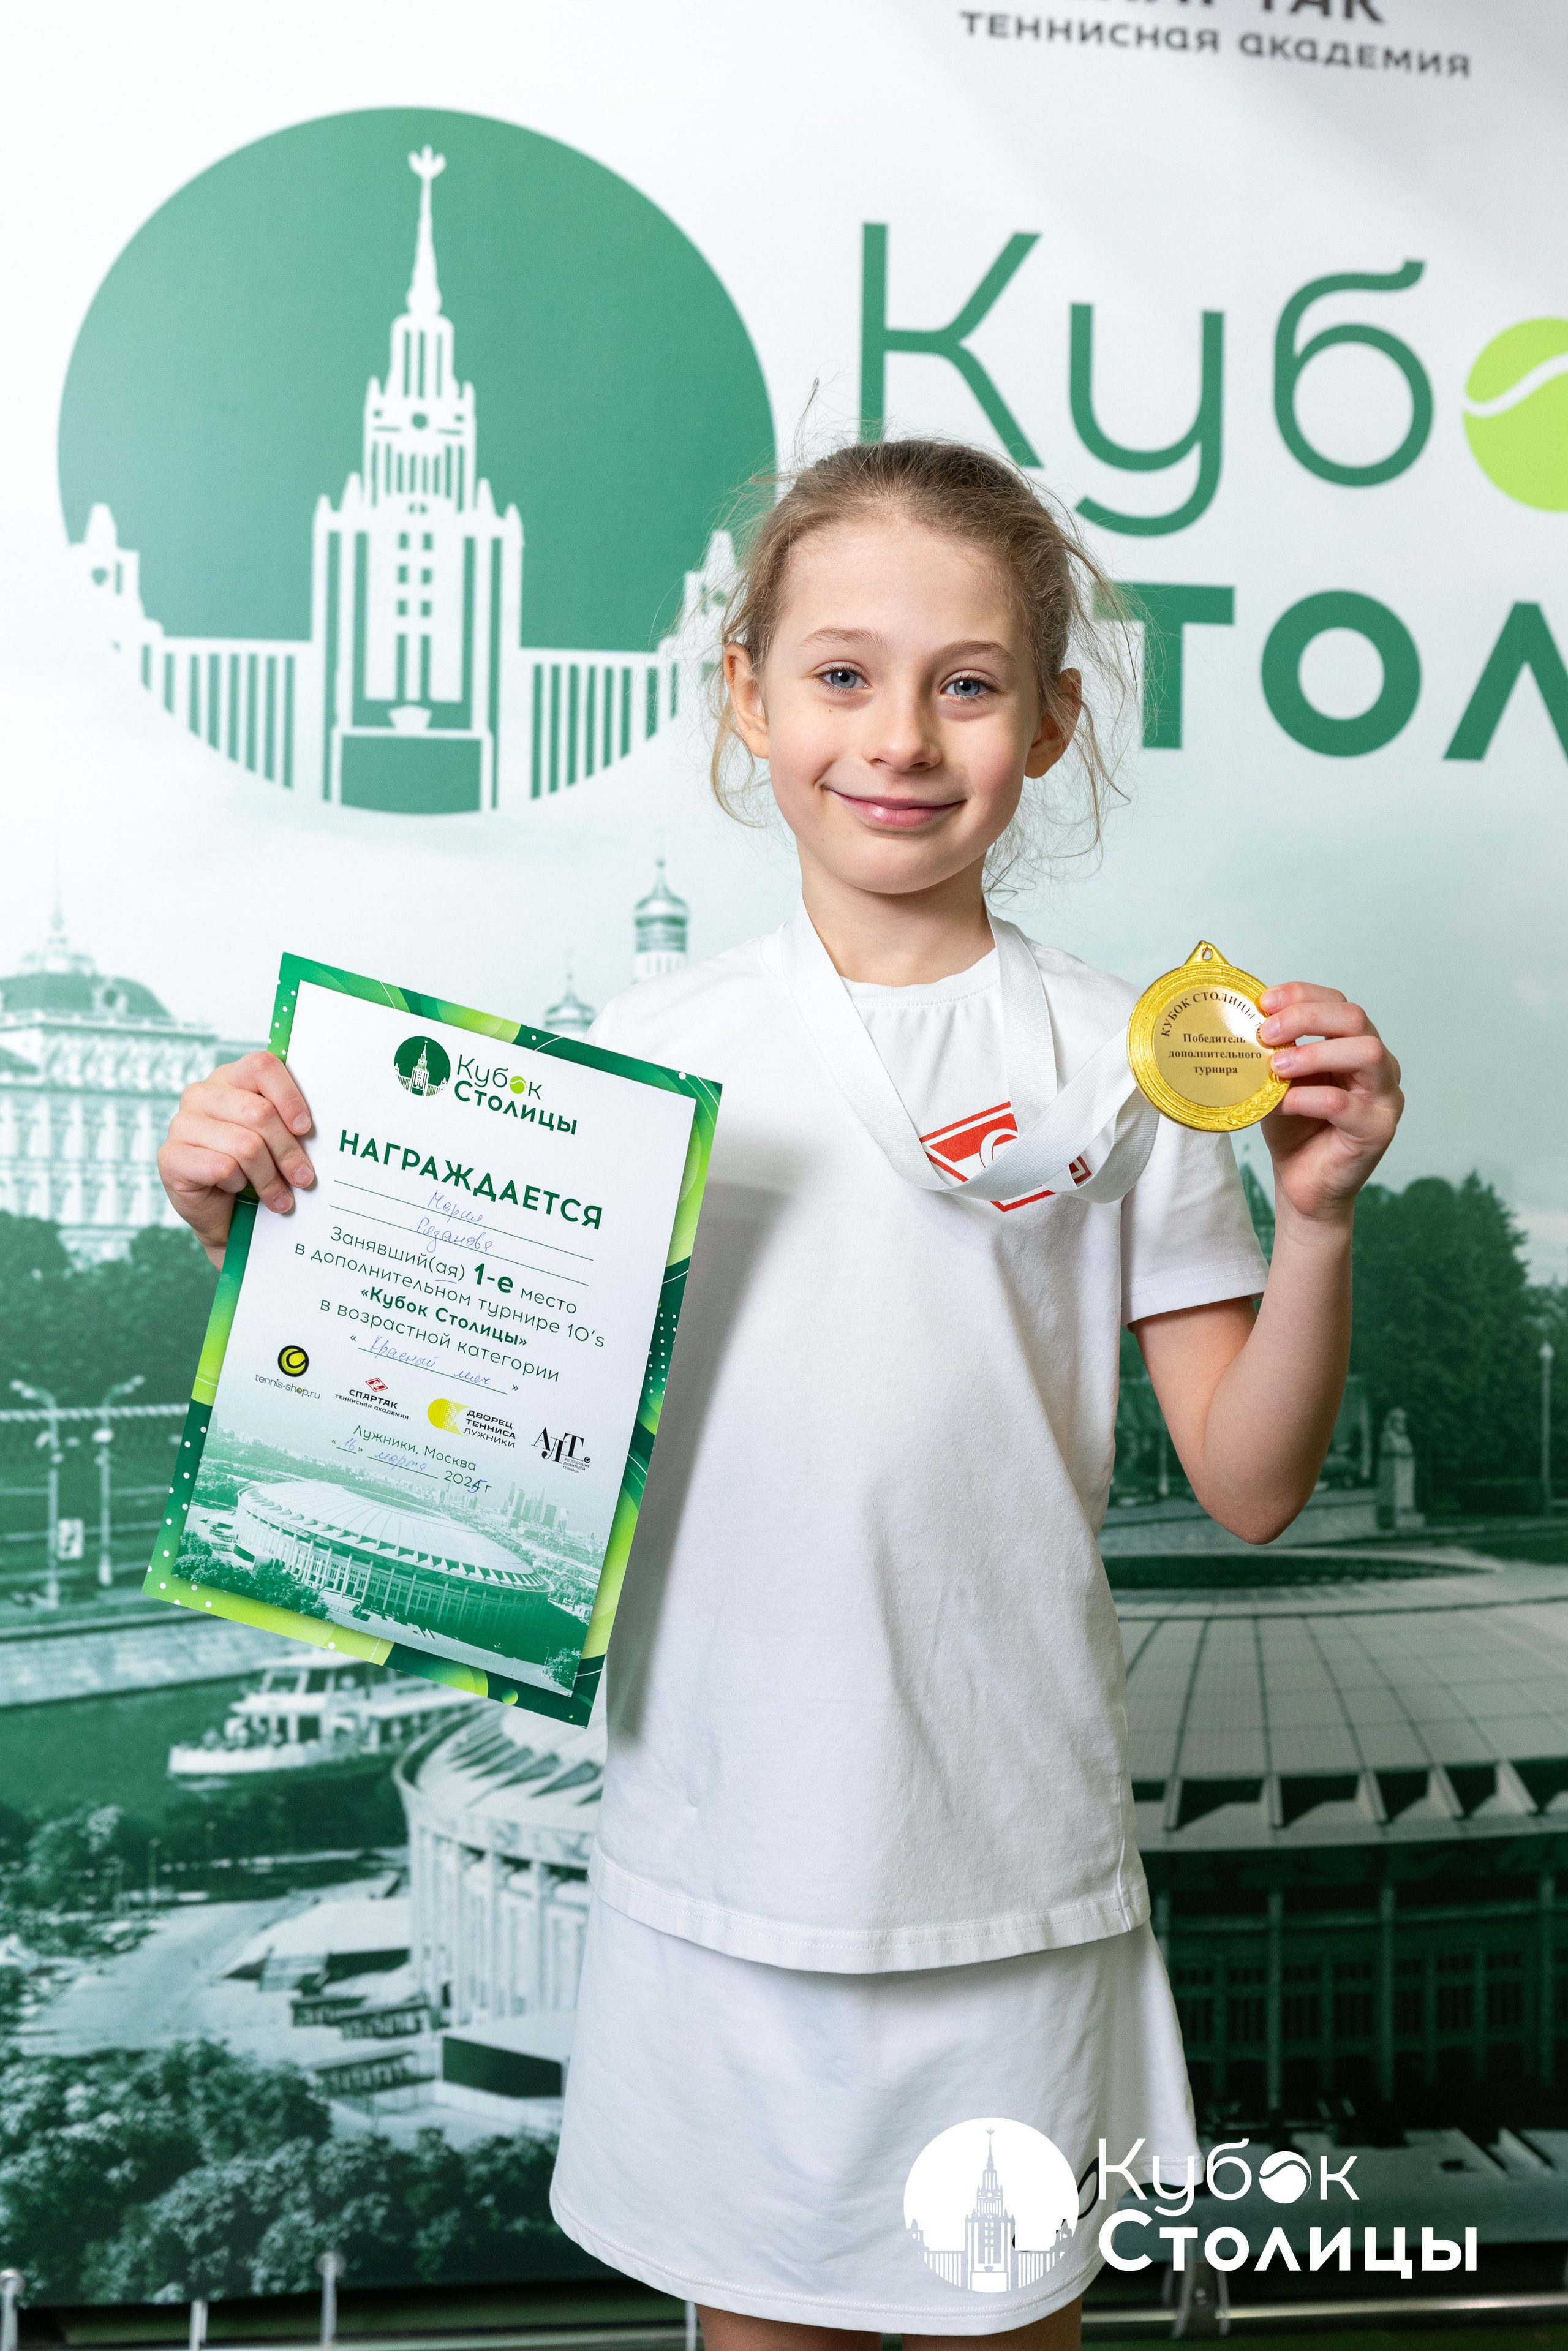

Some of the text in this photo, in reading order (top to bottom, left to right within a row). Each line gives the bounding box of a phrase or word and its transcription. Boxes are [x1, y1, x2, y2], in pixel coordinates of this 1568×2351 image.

[1161, 992, 1256, 1037] КУБОК СТОЛИЦЫ
[1168, 1050, 1262, 1059] дополнительного
[1183, 1033, 1246, 1044] Победитель
[457, 1054, 543, 1100] Кубок
[1194, 1066, 1238, 1076] турнира
[454, 1080, 577, 1135] Столицы
[339, 1129, 603, 1230] НАГРАЖДАЕТСЯ
[295, 1243, 305, 1255] в
[311, 1249, 471, 1306] дополнительном
[478, 1299, 560, 1334] турнире
[330, 1226, 577, 1314] Занявший(ая) 1-е место
[361, 1286, 527, 1346] «Кубок Столицы»
[320, 1299, 559, 1383] в возрастной категории
[255, 1374, 321, 1400] tennis-shop.ru
[349, 1389, 399, 1410] СПАРТАК
[463, 1427, 516, 1449] ЛУЖНИКИ
[466, 1418, 516, 1440] ТЕННИСА
[467, 1409, 513, 1430] ДВОРЕЦ
[353, 1425, 477, 1471] Лужники, Москва
